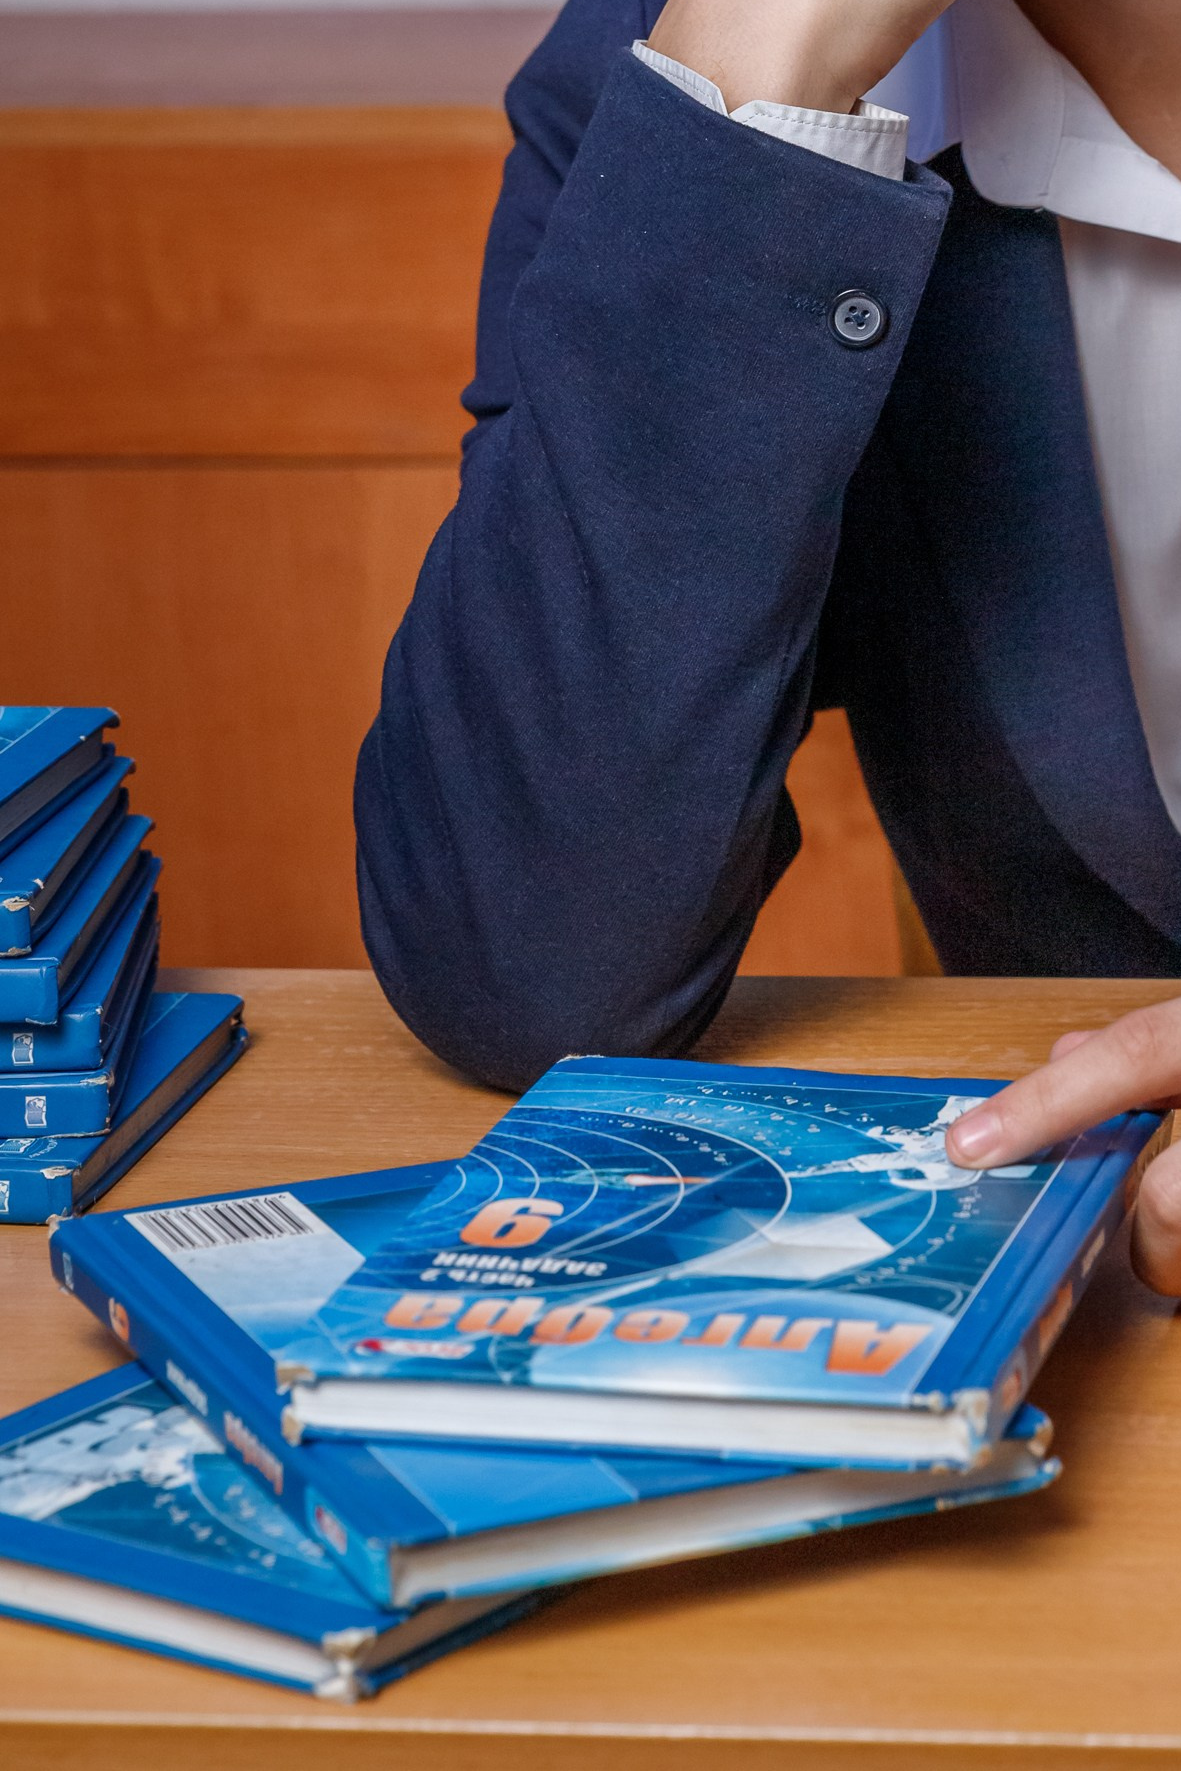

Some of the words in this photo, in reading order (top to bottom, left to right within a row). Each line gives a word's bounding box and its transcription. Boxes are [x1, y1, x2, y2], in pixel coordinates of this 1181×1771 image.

[459, 1197, 566, 1249] 9
[432, 1251, 608, 1277] ЗАДАЧНИК
[383, 1292, 934, 1377] Алгебра
